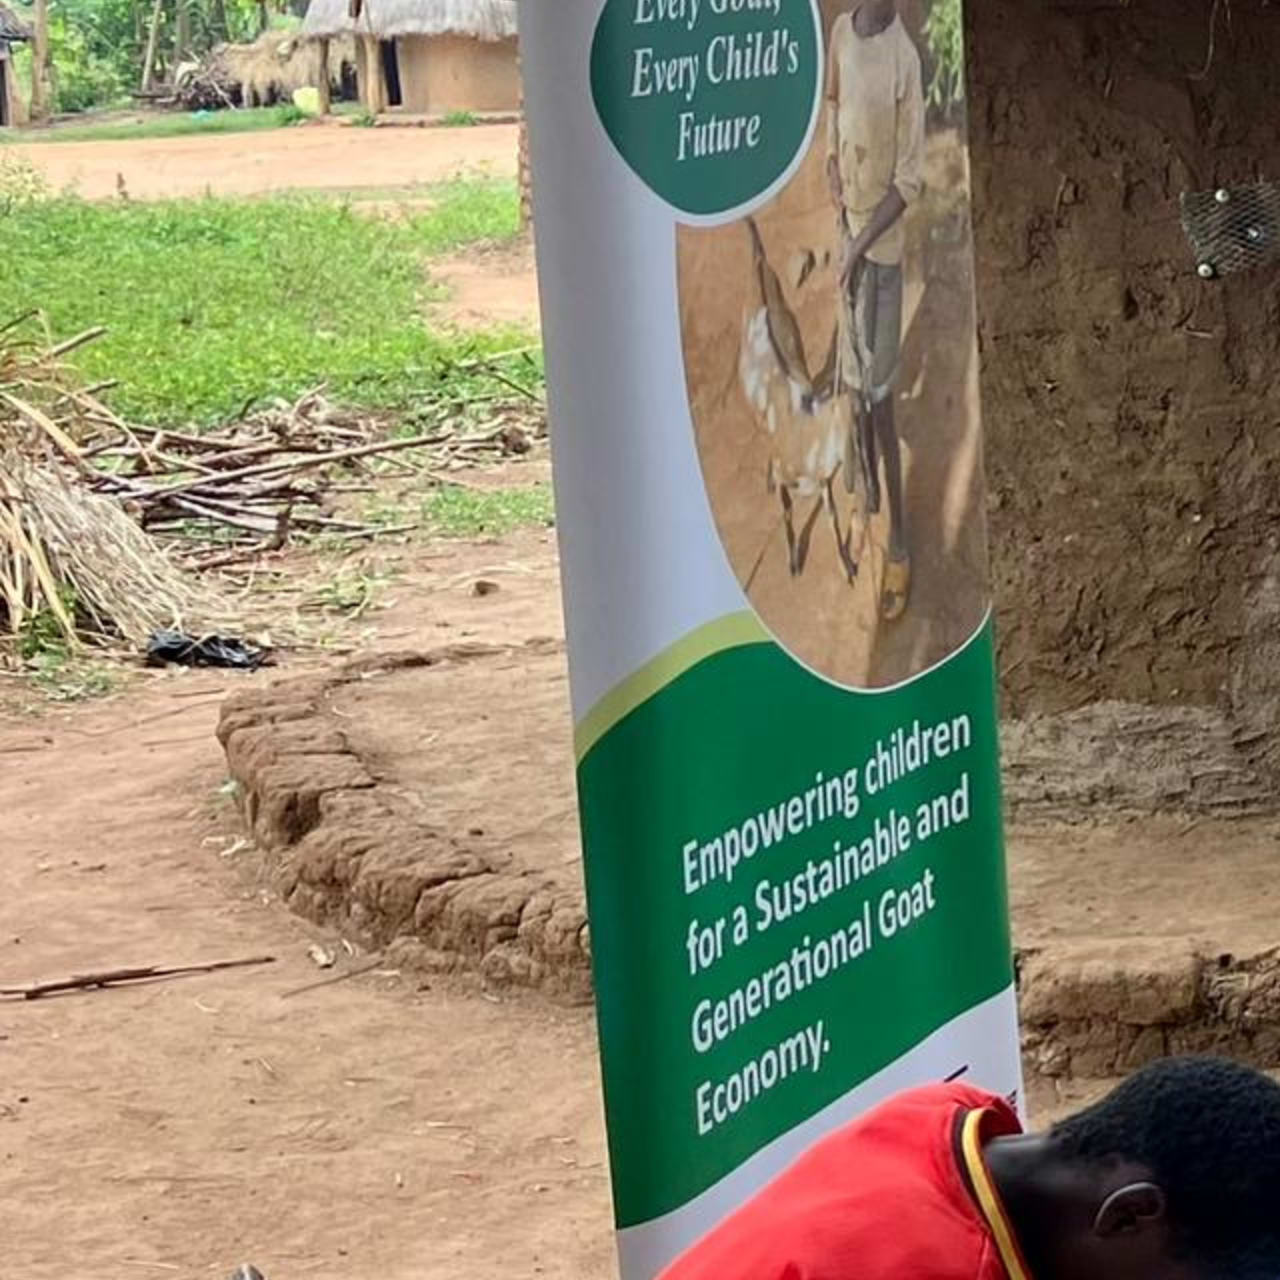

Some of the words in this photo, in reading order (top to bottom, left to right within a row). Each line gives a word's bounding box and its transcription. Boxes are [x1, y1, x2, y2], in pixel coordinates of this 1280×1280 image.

[631, 48, 699, 102] Every
[706, 29, 799, 85] Child's
[677, 111, 761, 161] Future
[682, 765, 859, 895] Empowering
[865, 714, 972, 796] children
[686, 918, 726, 976] for
[733, 905, 748, 945] a
[755, 809, 911, 932] Sustainable
[916, 773, 970, 842] and
[692, 901, 872, 1054] Generational
[878, 868, 936, 939] Goat
[697, 1019, 831, 1136] Economy.
